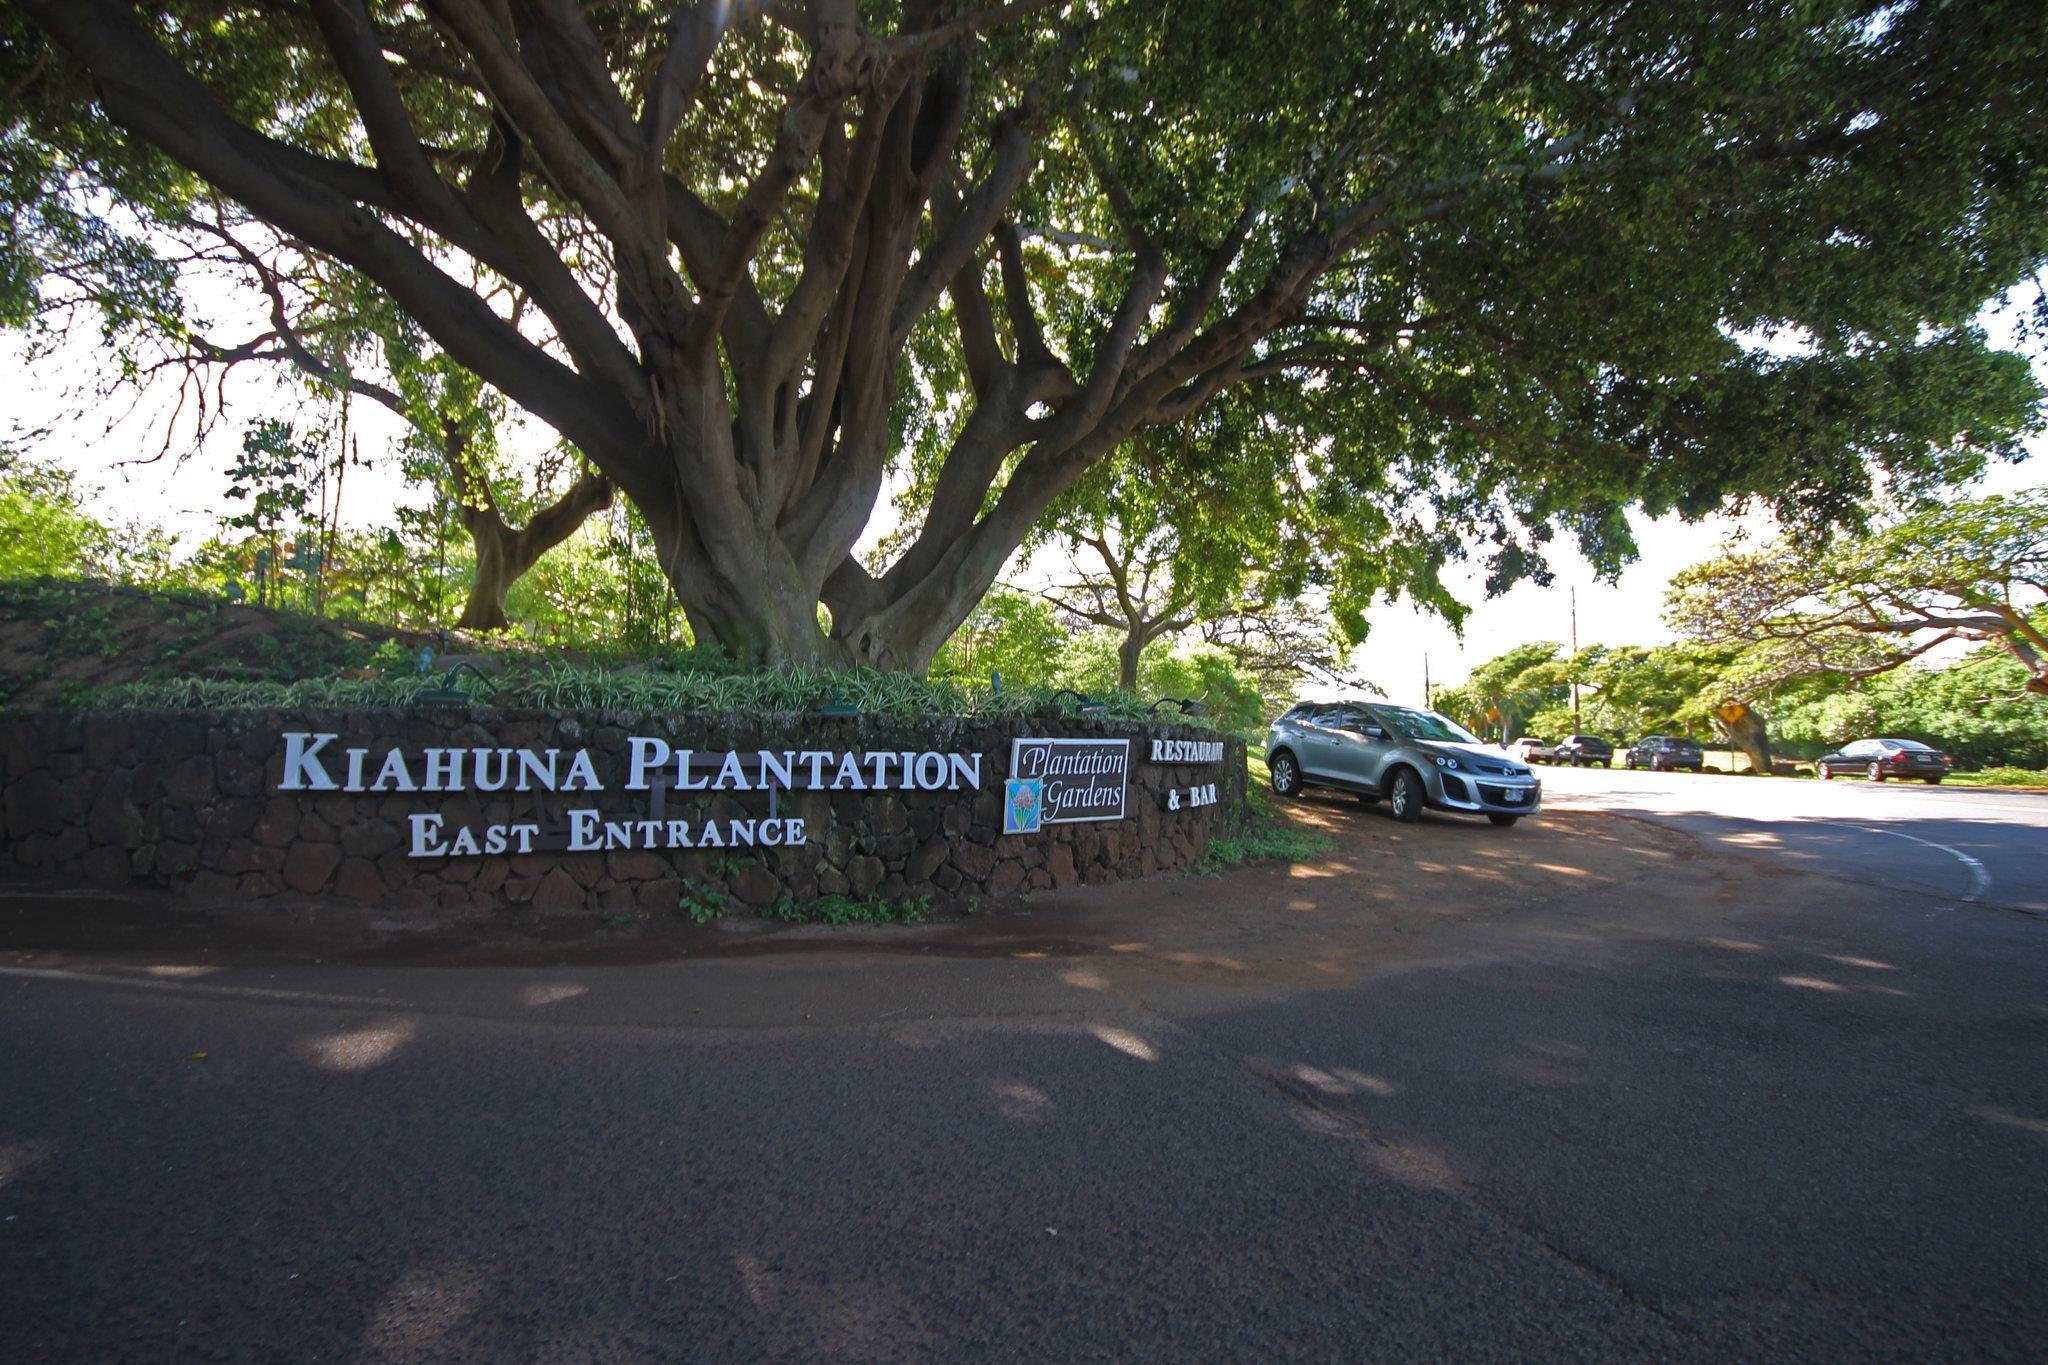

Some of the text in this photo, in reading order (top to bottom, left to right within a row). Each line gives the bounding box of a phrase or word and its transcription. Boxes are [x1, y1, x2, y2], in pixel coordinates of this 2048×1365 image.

[278, 732, 982, 792] KIAHUNA PLANTATION
[1023, 742, 1123, 776] Plantation
[1151, 739, 1224, 762] RESTAURANT
[1043, 775, 1121, 820] Gardens
[1168, 783, 1217, 811] & BAR
[408, 809, 807, 857] EAST ENTRANCE
